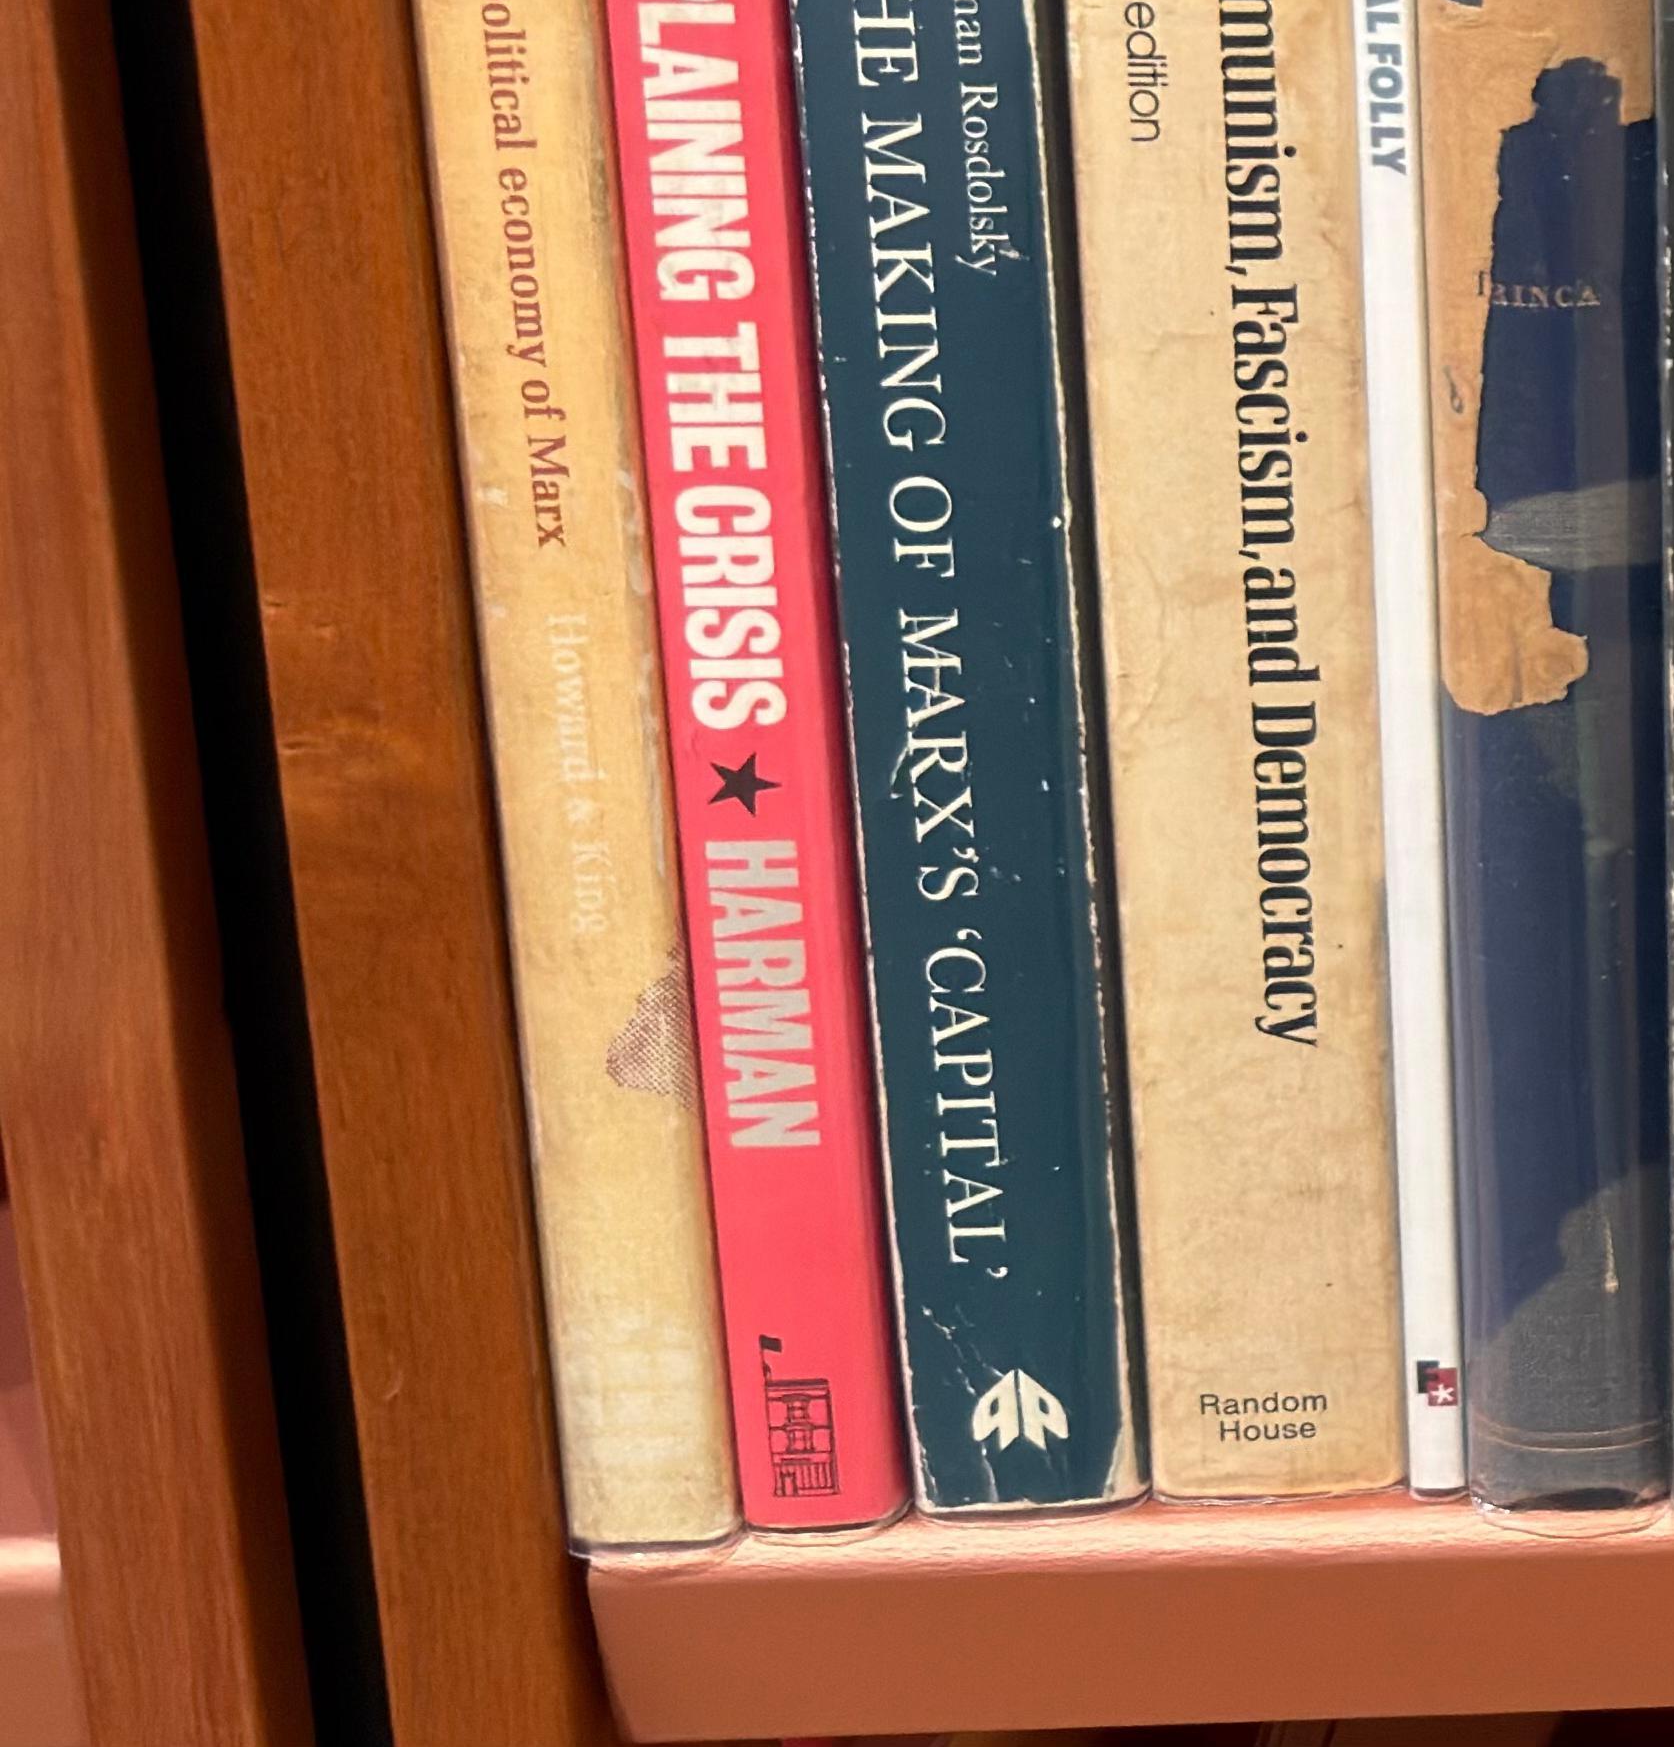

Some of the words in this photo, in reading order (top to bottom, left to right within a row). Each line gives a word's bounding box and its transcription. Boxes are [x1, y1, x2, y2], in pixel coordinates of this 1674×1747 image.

[1123, 0, 1168, 142] edition
[1368, 43, 1408, 175] FOLLY
[955, 82, 998, 277] Rosdolsky
[660, 321, 766, 472] THE
[673, 489, 787, 730] CRISIS
[705, 840, 820, 1148] HARMAN
[1199, 1391, 1329, 1417] Random
[1218, 1416, 1318, 1442] House
